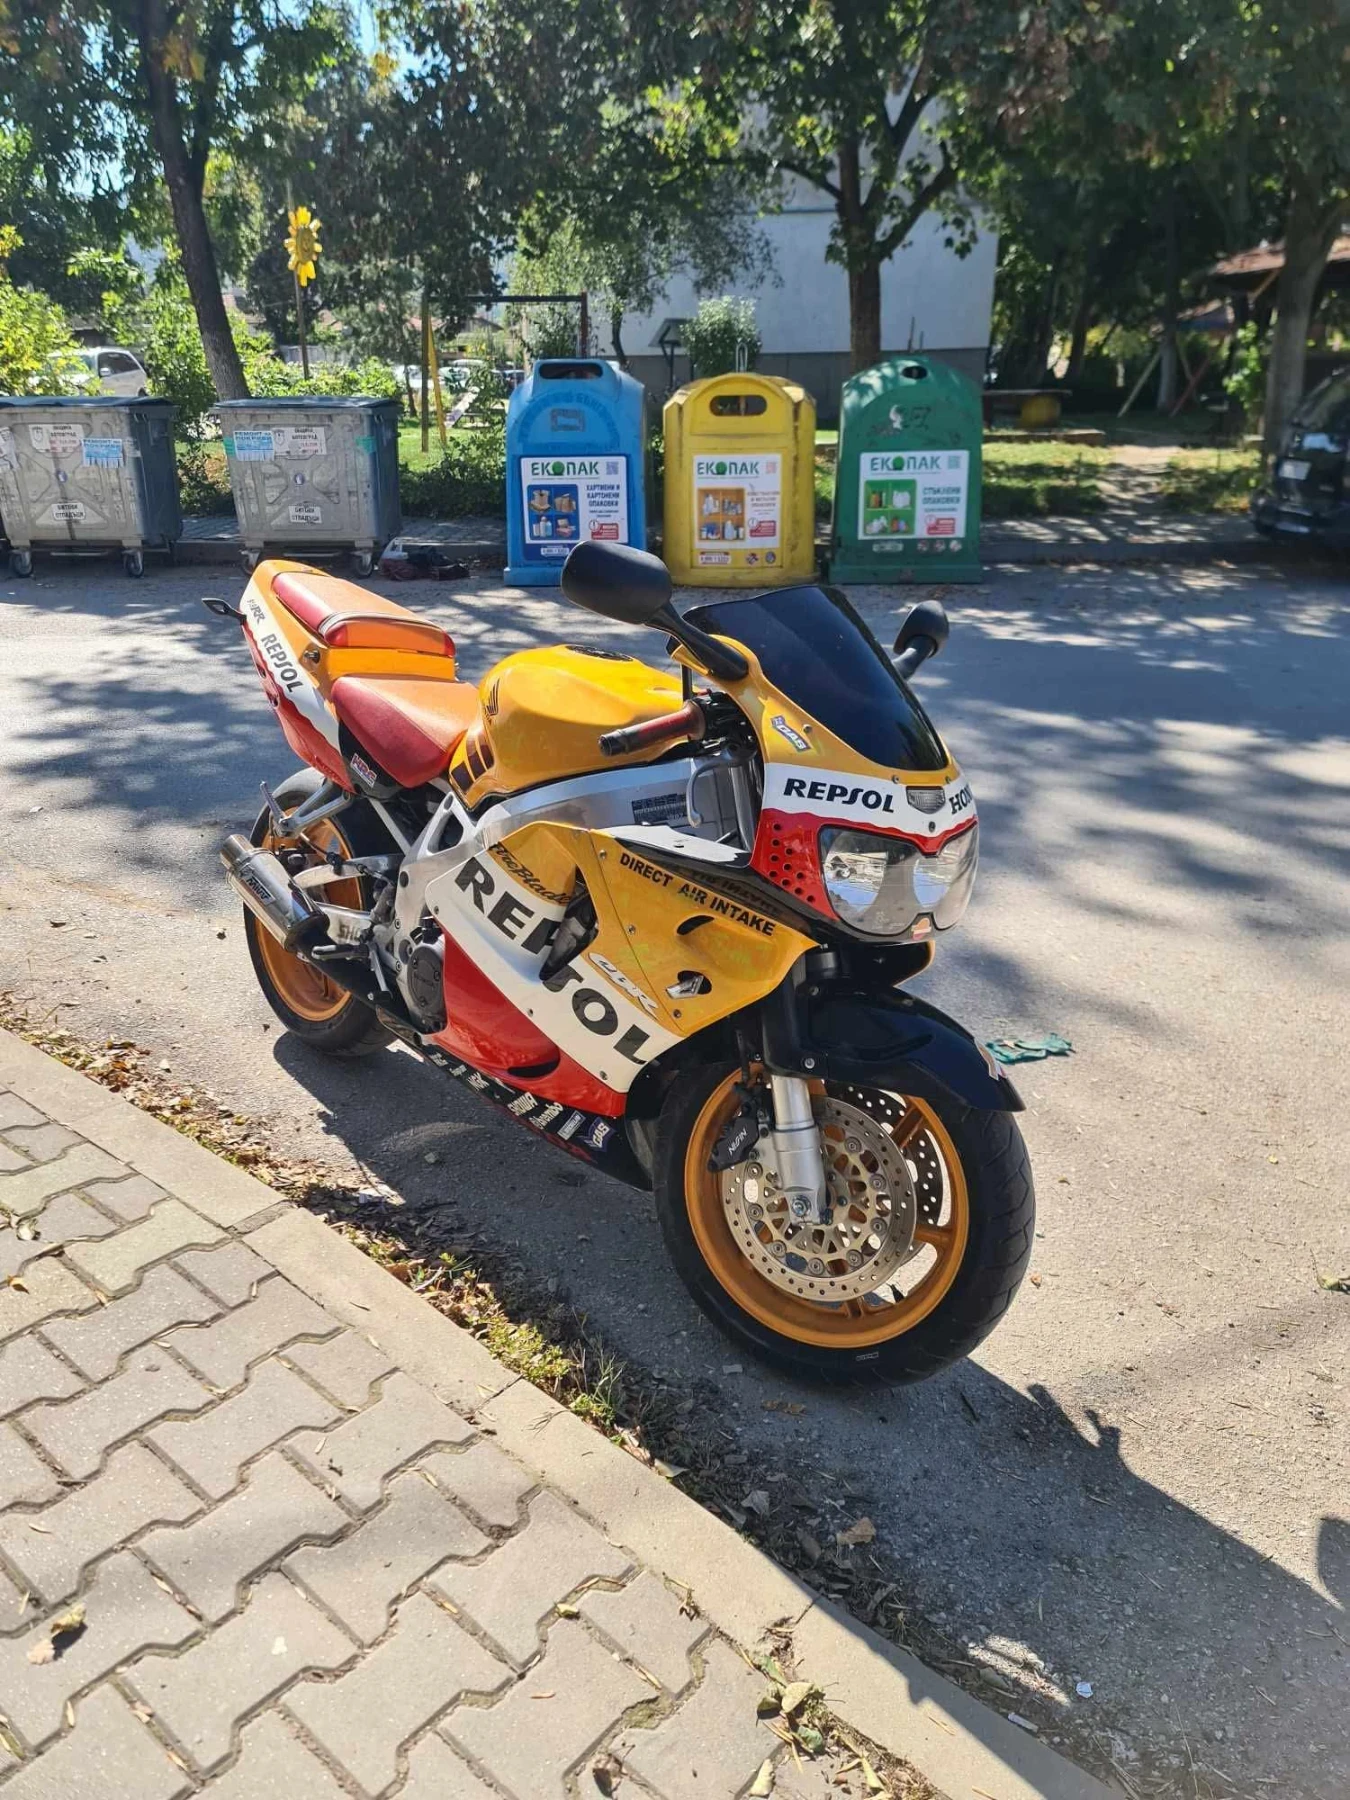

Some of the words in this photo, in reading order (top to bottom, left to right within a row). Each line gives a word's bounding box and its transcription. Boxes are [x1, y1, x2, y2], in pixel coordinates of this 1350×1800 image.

[531, 461, 600, 476] ЕКОПАК
[697, 461, 760, 475] ЕКОПАК
[870, 455, 942, 471] ЕКОПАК
[261, 633, 304, 693] REPSOL
[783, 778, 895, 814] REPSOL
[620, 853, 673, 887] DIRECT
[678, 884, 707, 905] AIR
[710, 897, 776, 936] INTAKE
[592, 1122, 610, 1148] GAS
